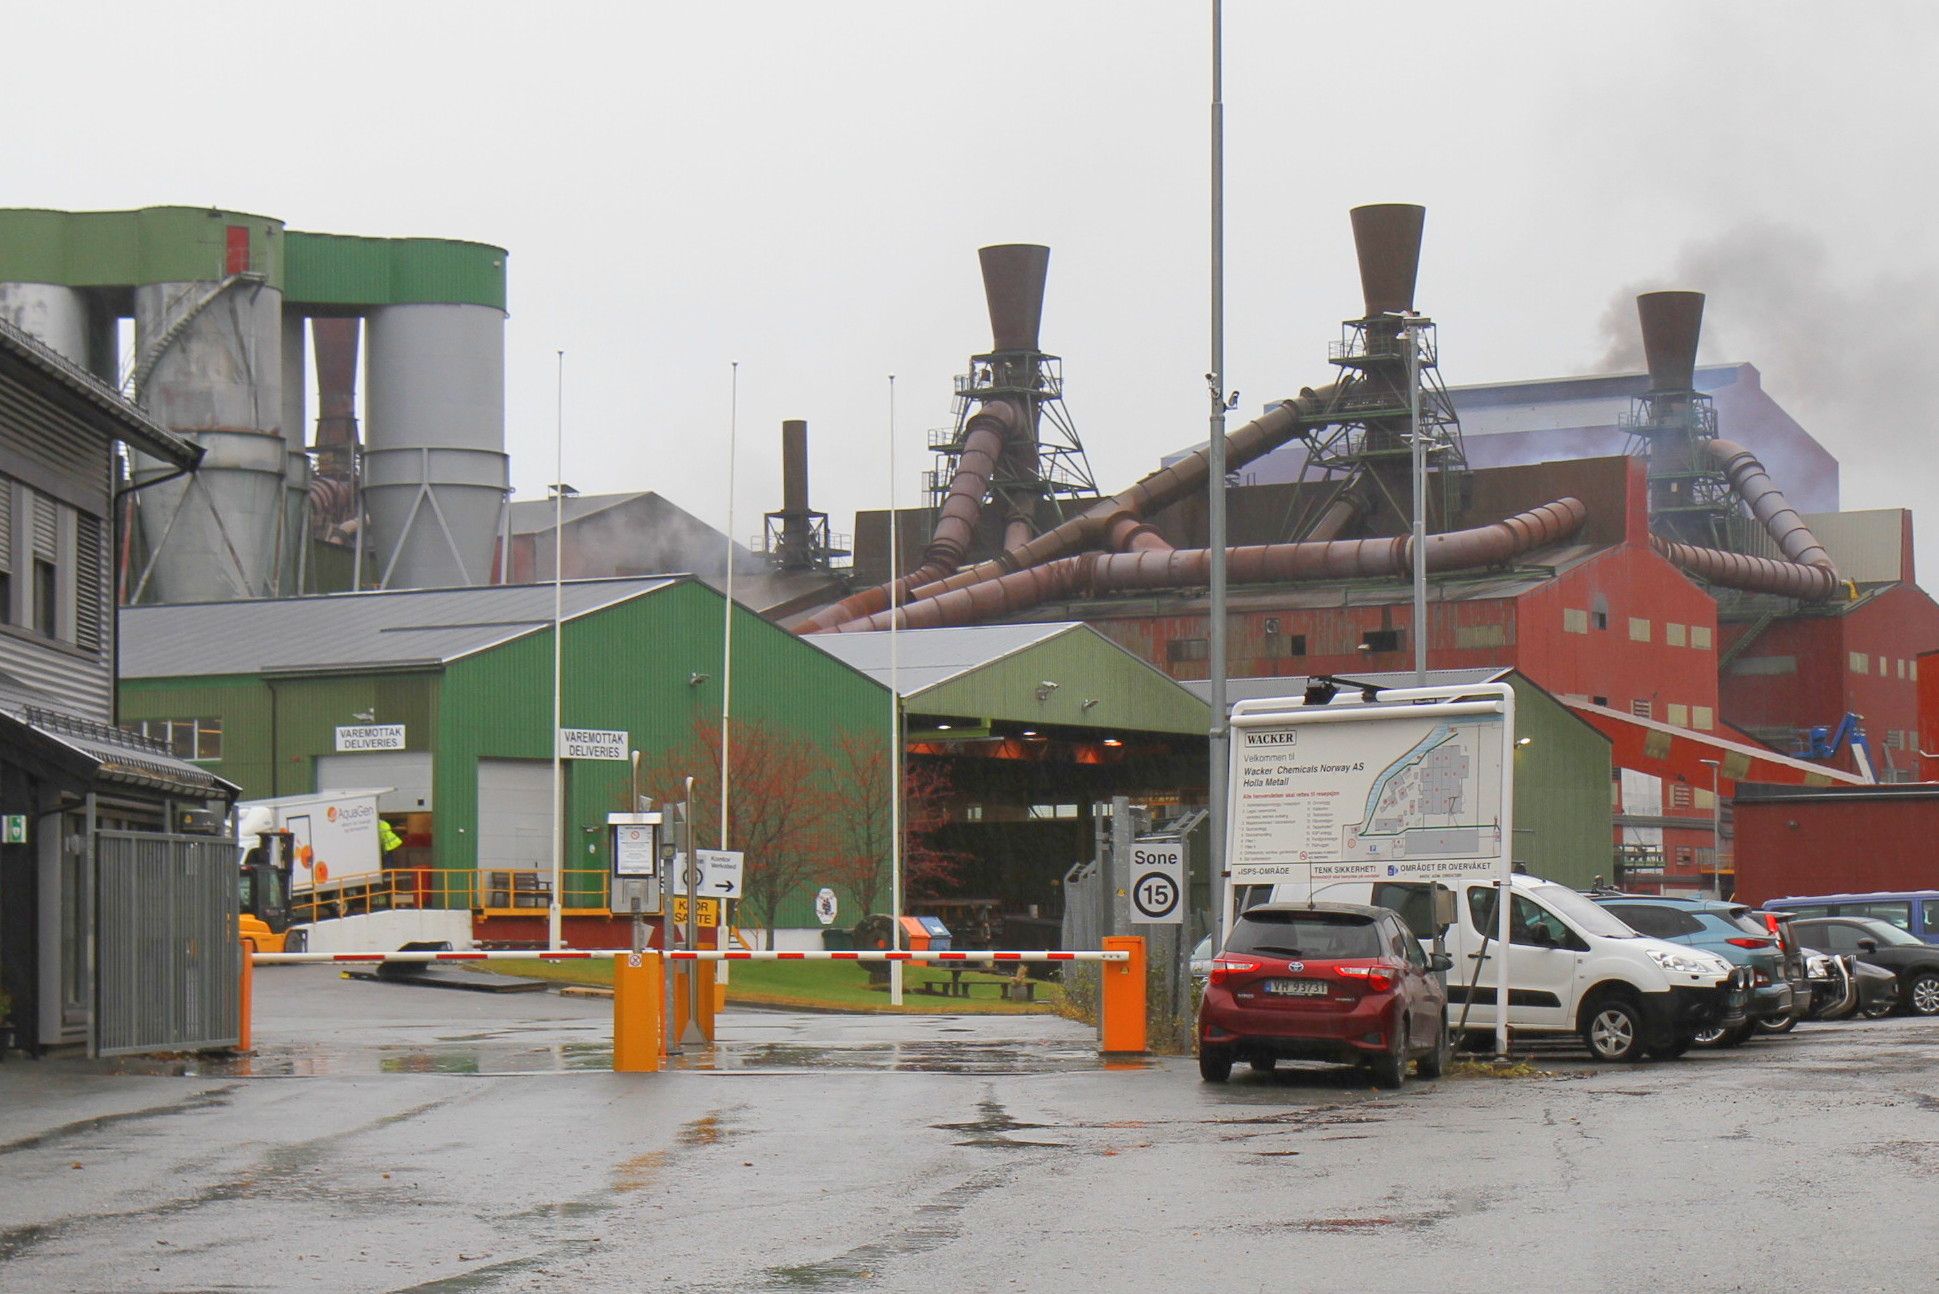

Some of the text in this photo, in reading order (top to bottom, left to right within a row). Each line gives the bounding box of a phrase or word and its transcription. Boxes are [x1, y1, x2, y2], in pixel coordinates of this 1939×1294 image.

[340, 727, 402, 738] VAREMOTTAK
[564, 731, 624, 744] VAREMOTTAK
[344, 738, 398, 749] DELIVERIES
[1247, 733, 1294, 745] WACKER
[569, 745, 620, 758] DELIVERIES
[1244, 753, 1287, 763] Velkommen
[1244, 762, 1365, 776] Wacker Chemicals Norway AS
[1243, 777, 1289, 787] Holla Metall
[339, 805, 374, 819] AquaGen
[1134, 850, 1178, 865] Sone
[1315, 865, 1332, 874] TENK
[1400, 861, 1491, 872] OMRÅDET ER OVERVÅKET
[1143, 885, 1168, 905] 15
[675, 913, 711, 925] SATE
